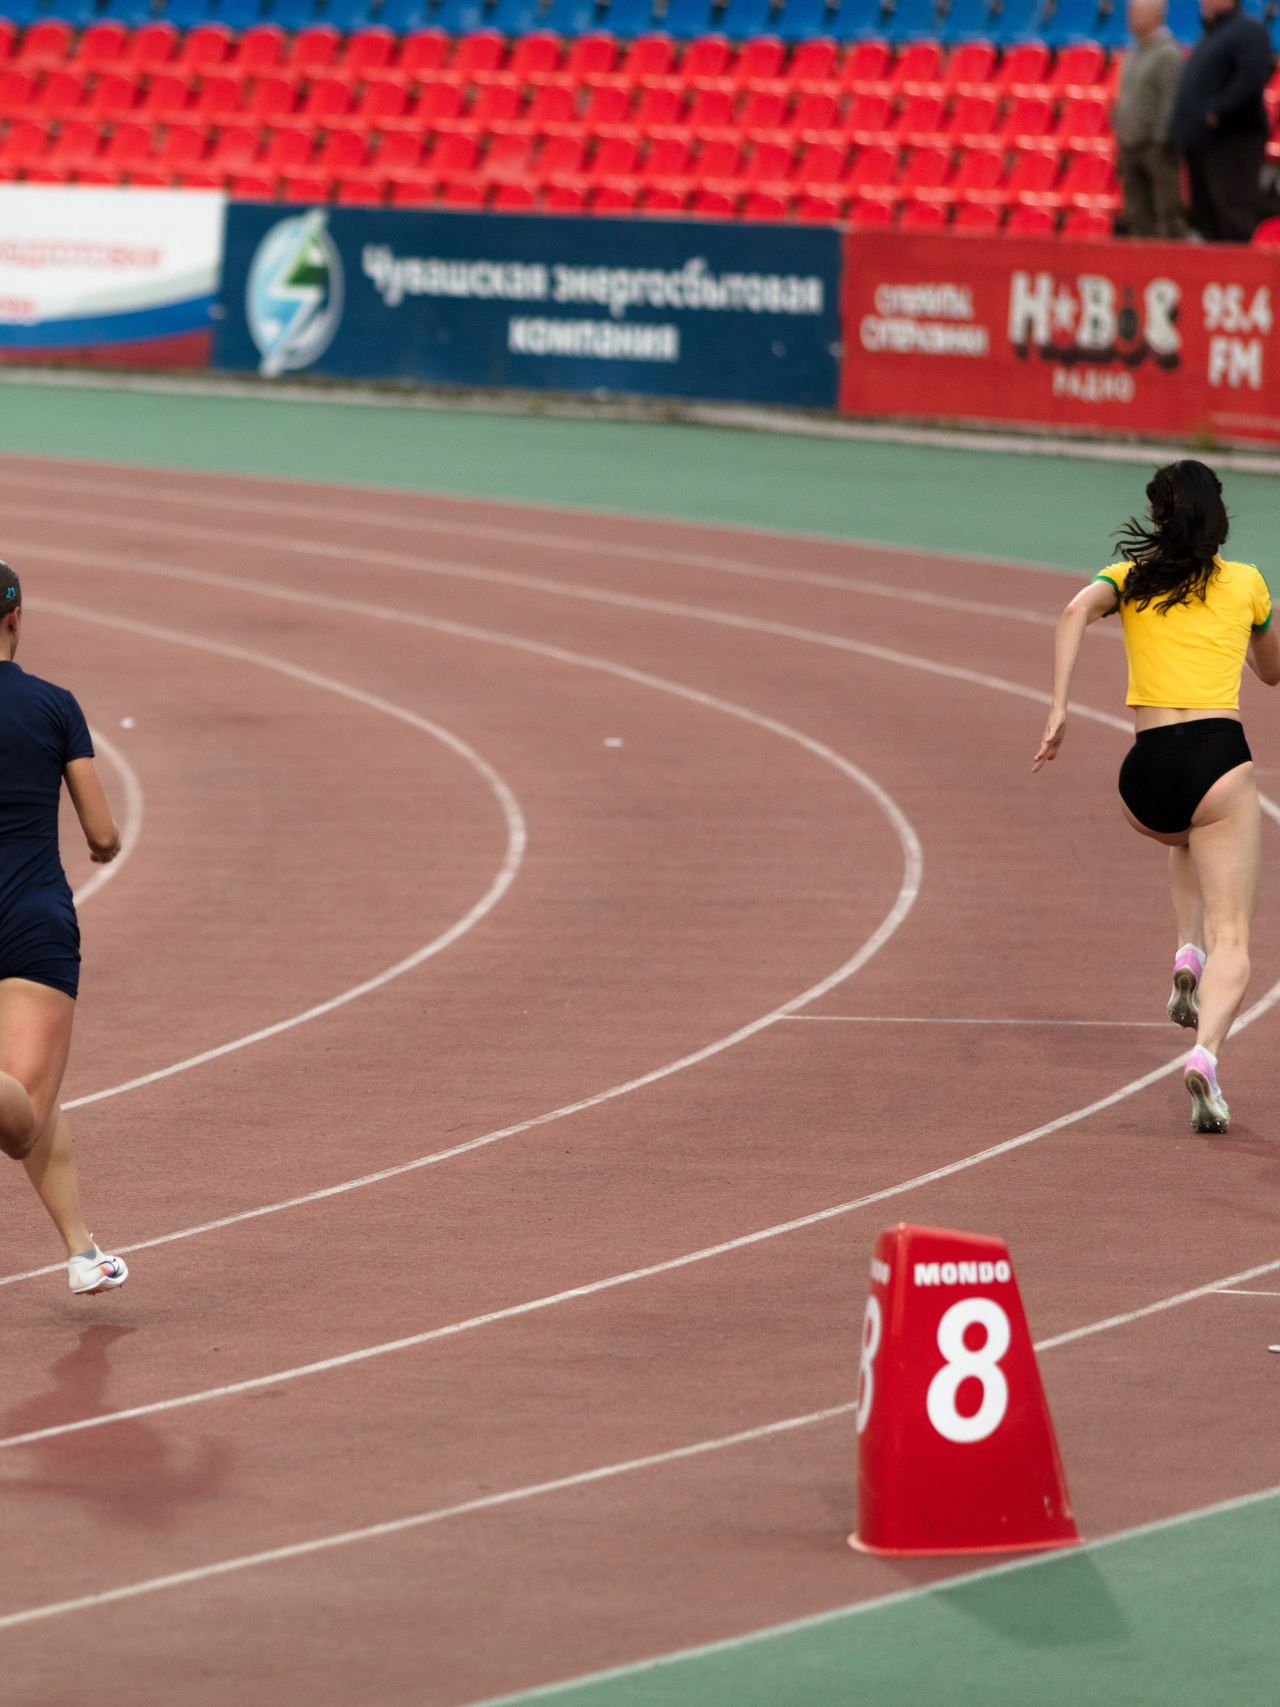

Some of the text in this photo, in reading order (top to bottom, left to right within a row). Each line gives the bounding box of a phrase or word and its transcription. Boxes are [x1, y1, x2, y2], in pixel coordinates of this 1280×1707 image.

[362, 243, 549, 308] Чувашская
[553, 256, 823, 317] энергосбытовая
[508, 314, 679, 364] компания
[1208, 336, 1263, 389] FM
[914, 1260, 1011, 1287] MONDO
[926, 1297, 1011, 1444] 8
